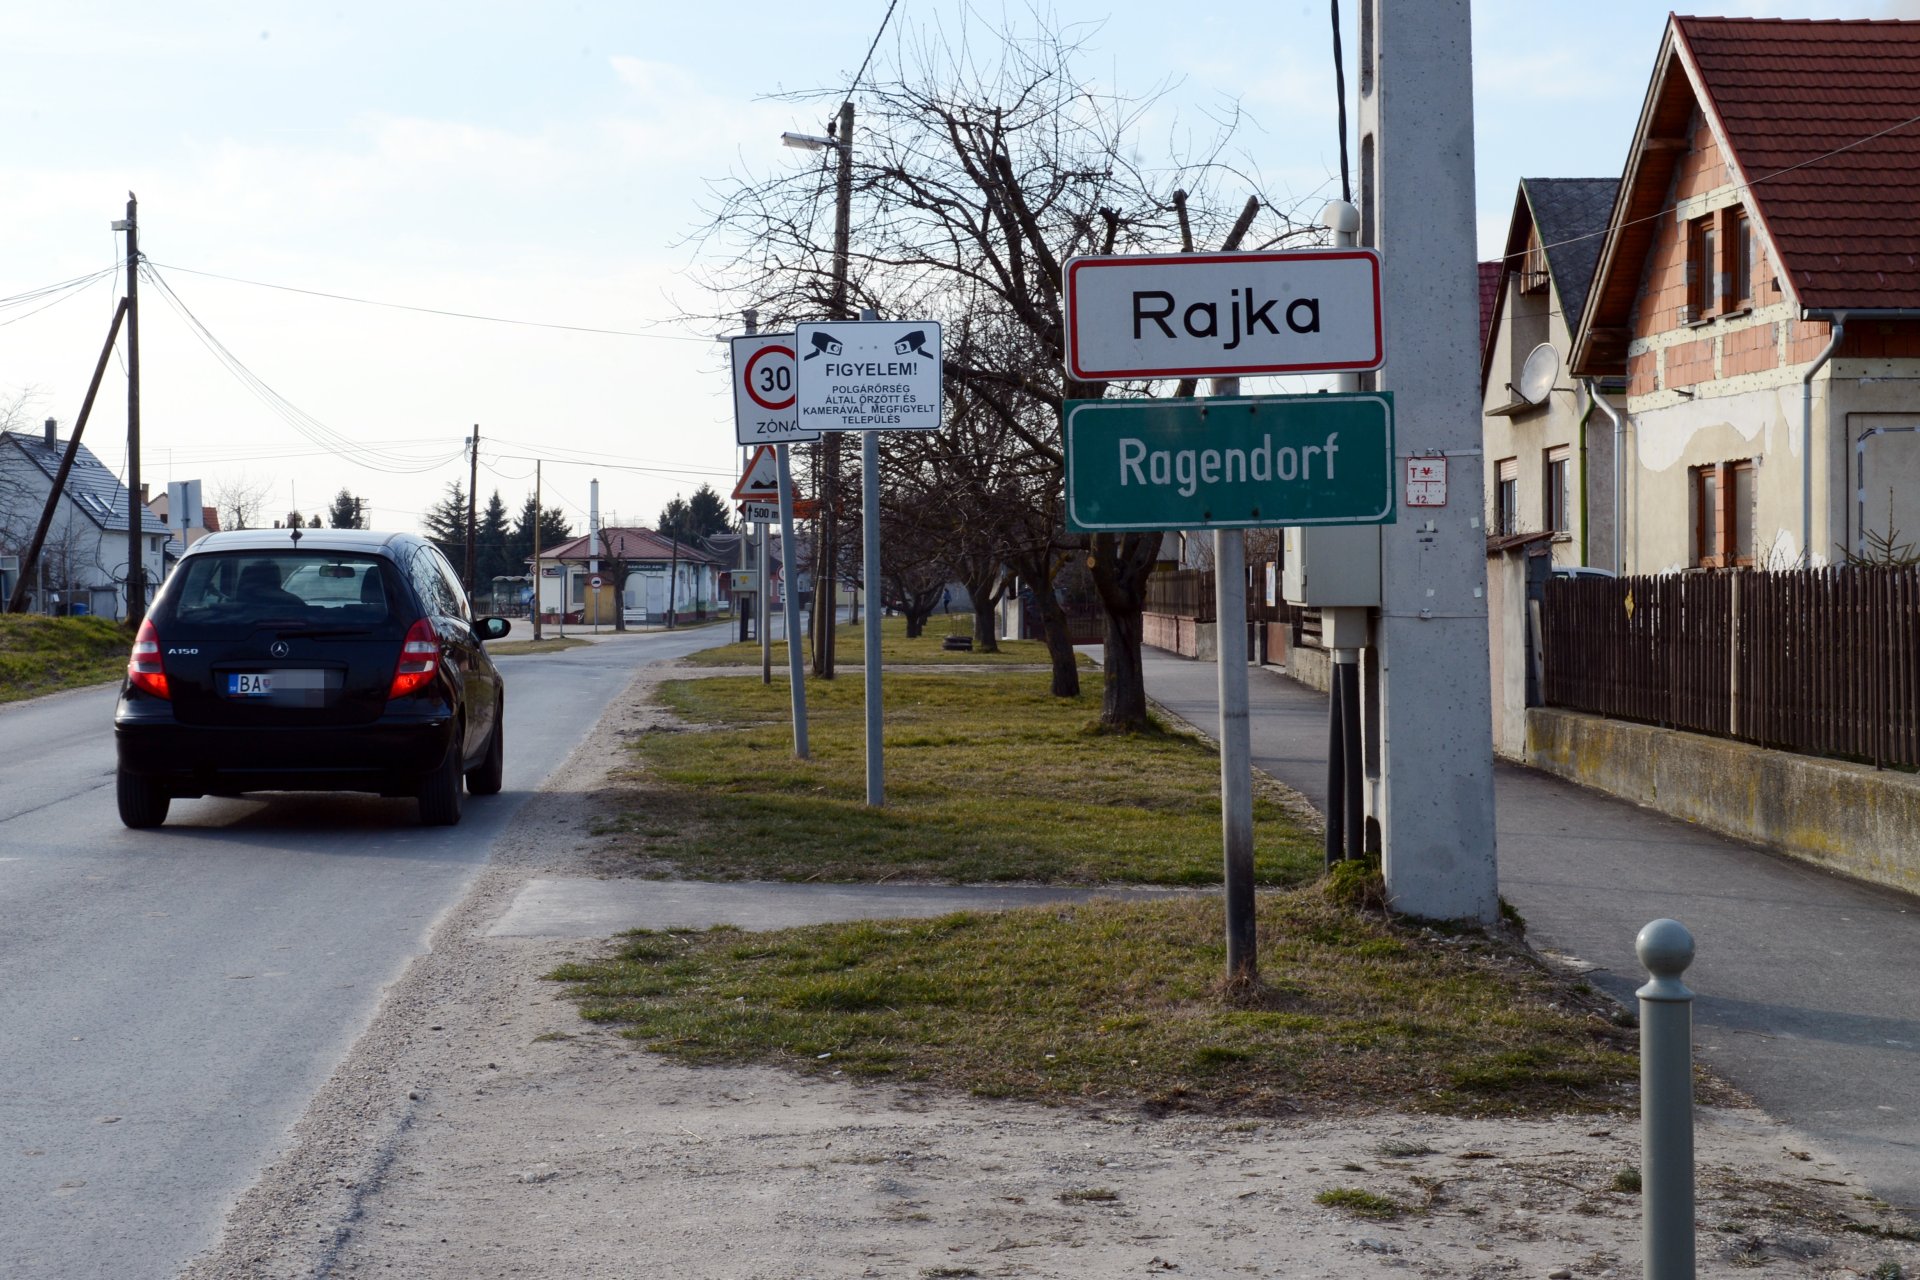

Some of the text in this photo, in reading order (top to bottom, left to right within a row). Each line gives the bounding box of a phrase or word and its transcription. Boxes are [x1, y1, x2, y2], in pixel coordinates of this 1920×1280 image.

[1133, 287, 1320, 350] Rajka
[826, 362, 917, 376] FIGYELEM!
[760, 366, 791, 392] 30
[832, 383, 910, 393] POLGÁRŐRSÉG
[825, 392, 916, 405] ÁLTAL ŐRZÖTT ÉS
[803, 404, 935, 415] KAMERÁVAL MEGFIGYELT
[842, 413, 900, 424] TELEPÜLÉS
[1119, 432, 1339, 498] Ragendorf
[754, 508, 769, 518] 500
[240, 676, 262, 692] BA
